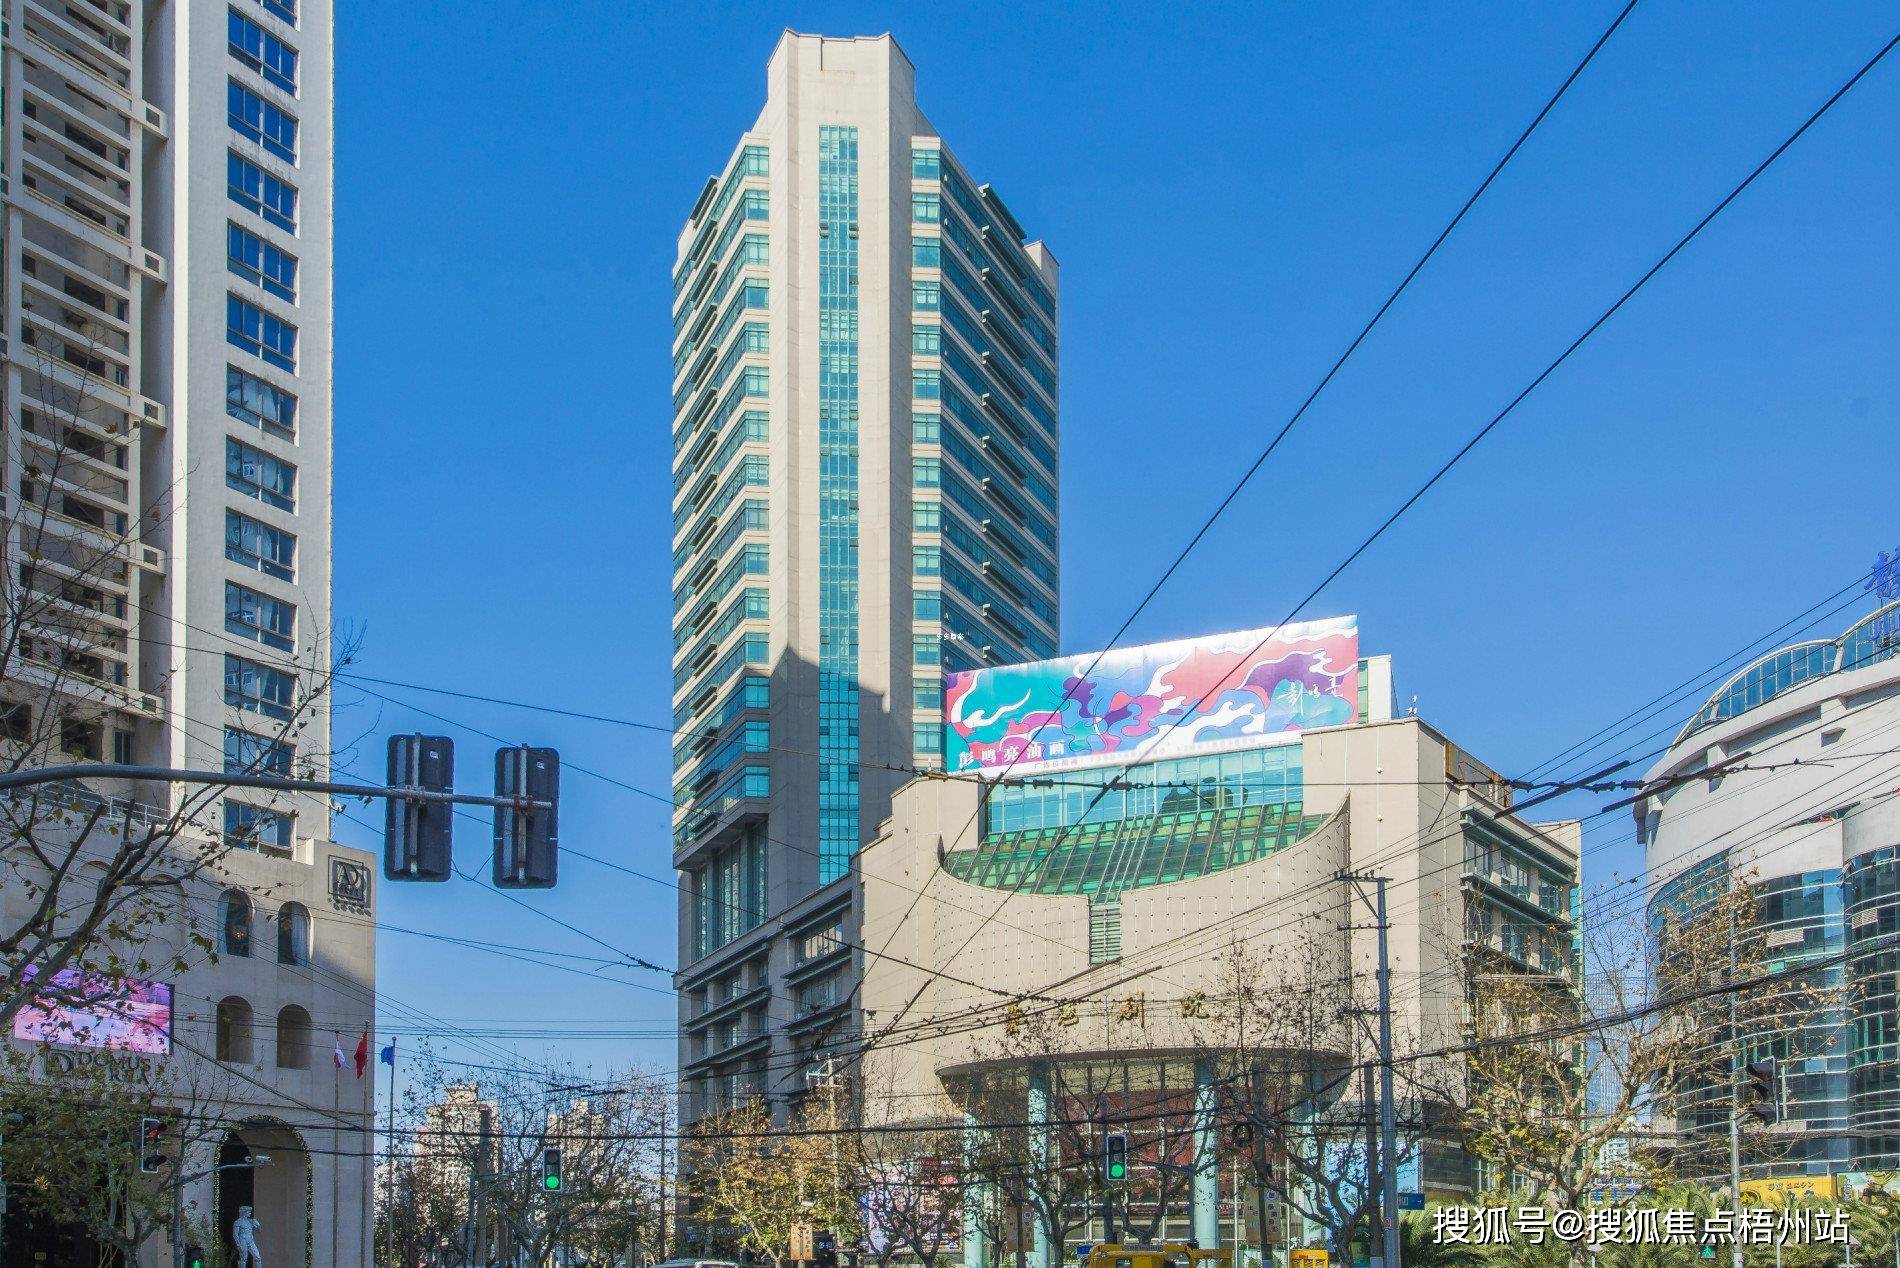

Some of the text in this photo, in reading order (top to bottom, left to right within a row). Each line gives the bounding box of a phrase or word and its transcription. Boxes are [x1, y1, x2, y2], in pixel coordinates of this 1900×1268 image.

[958, 740, 1066, 769] 彭鸣亮油画
